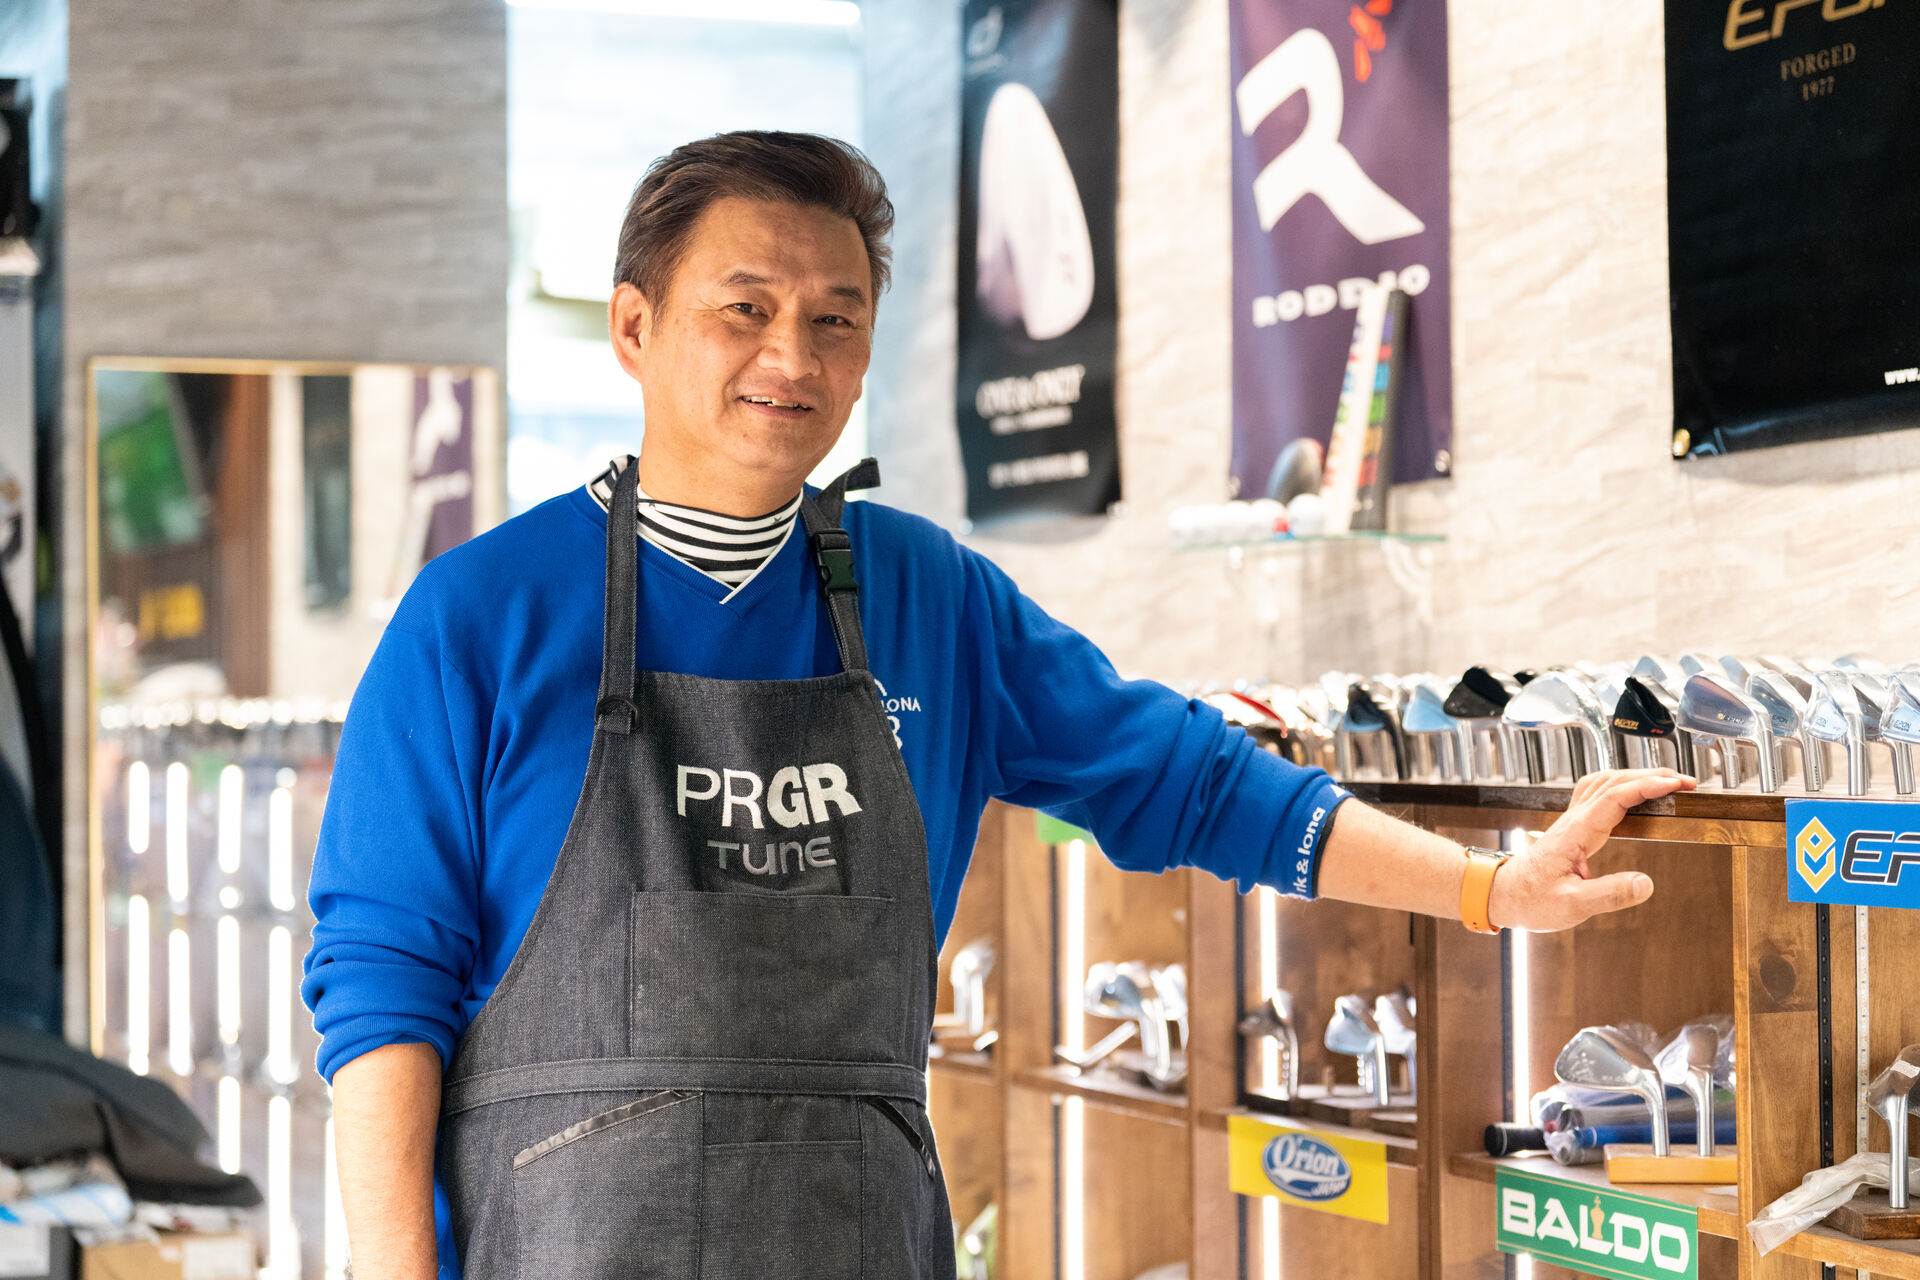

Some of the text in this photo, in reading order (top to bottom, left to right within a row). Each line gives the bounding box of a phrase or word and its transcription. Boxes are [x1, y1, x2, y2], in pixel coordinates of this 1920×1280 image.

[1781, 42, 1857, 81] FORGED
[1802, 76, 1835, 101] 1977
[677, 763, 863, 829] PRGR
[1298, 807, 1326, 855] lona
[1296, 858, 1309, 875] &
[1502, 1187, 1690, 1274] BALDO
